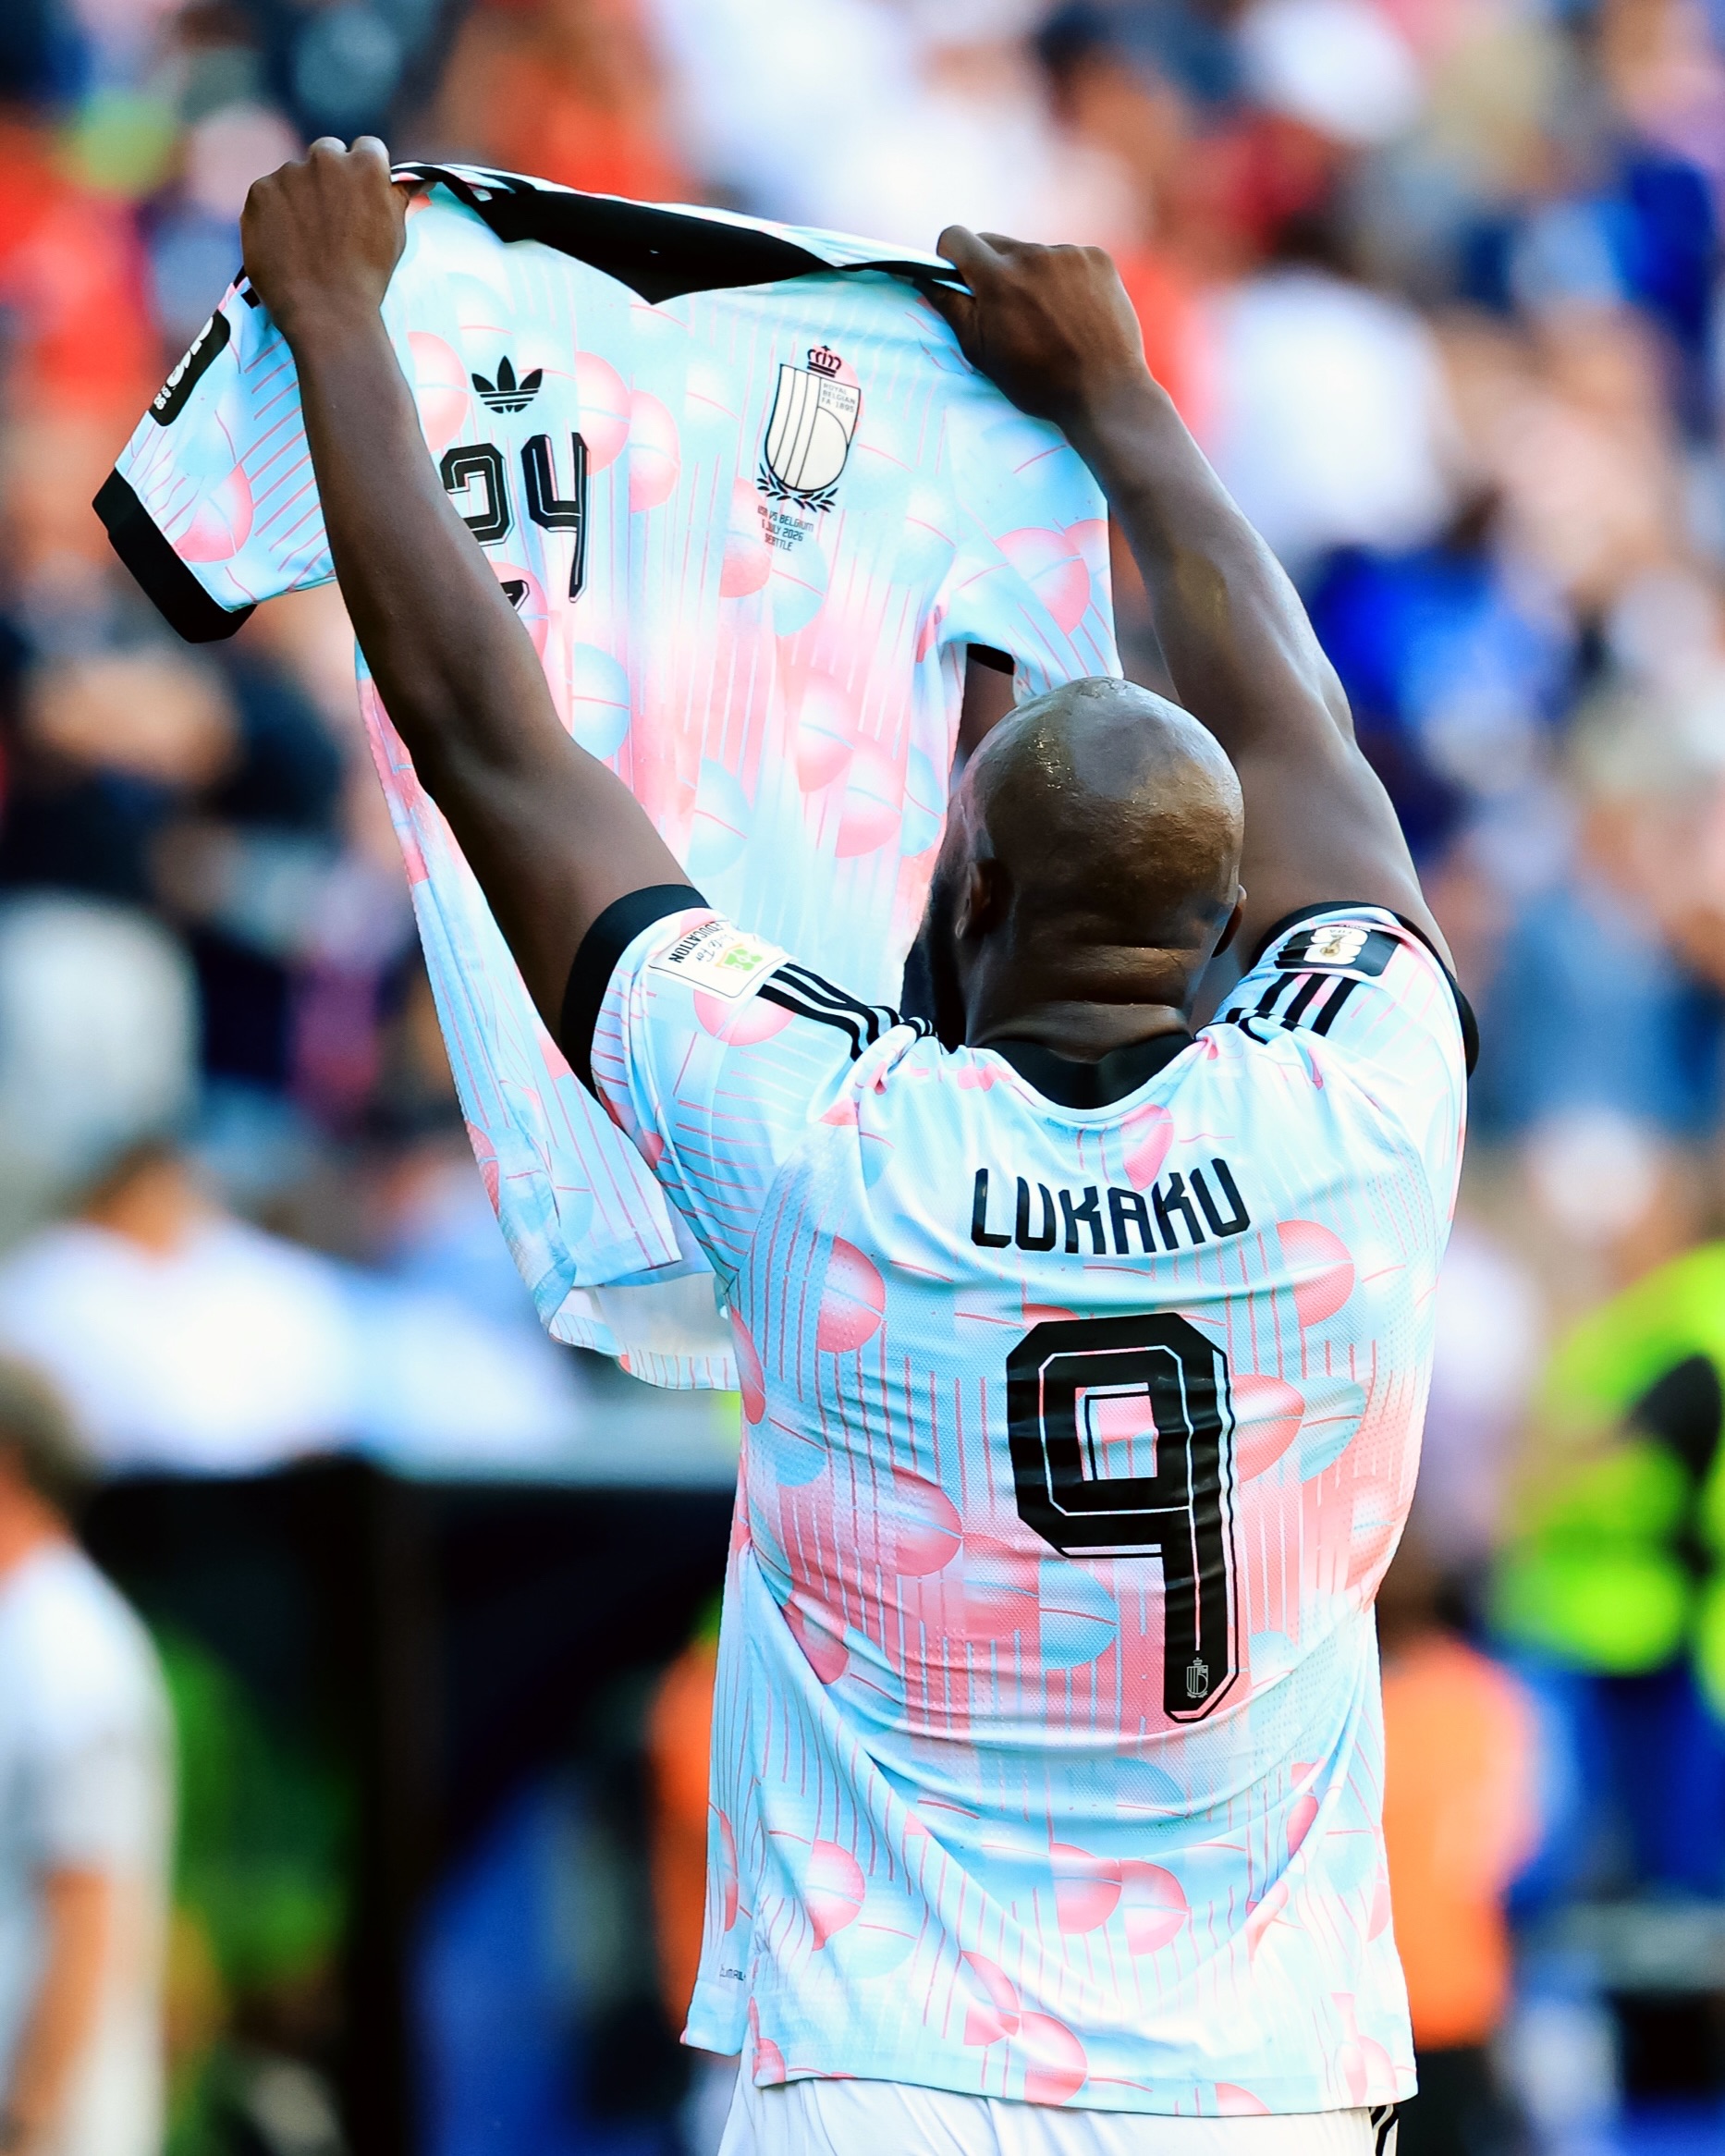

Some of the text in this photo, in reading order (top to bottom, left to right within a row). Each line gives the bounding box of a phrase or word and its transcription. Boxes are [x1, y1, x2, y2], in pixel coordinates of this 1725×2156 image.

[823, 383, 847, 395] ROYAL
[823, 389, 855, 405] BELGIAN
[822, 397, 854, 412] FA 1895
[779, 514, 814, 533] BELGIUM
[782, 528, 804, 542] 2026
[668, 921, 724, 963] EDUCATION
[971, 1158, 1251, 1255] LUKAKU
[1006, 1312, 1240, 1723] 9
